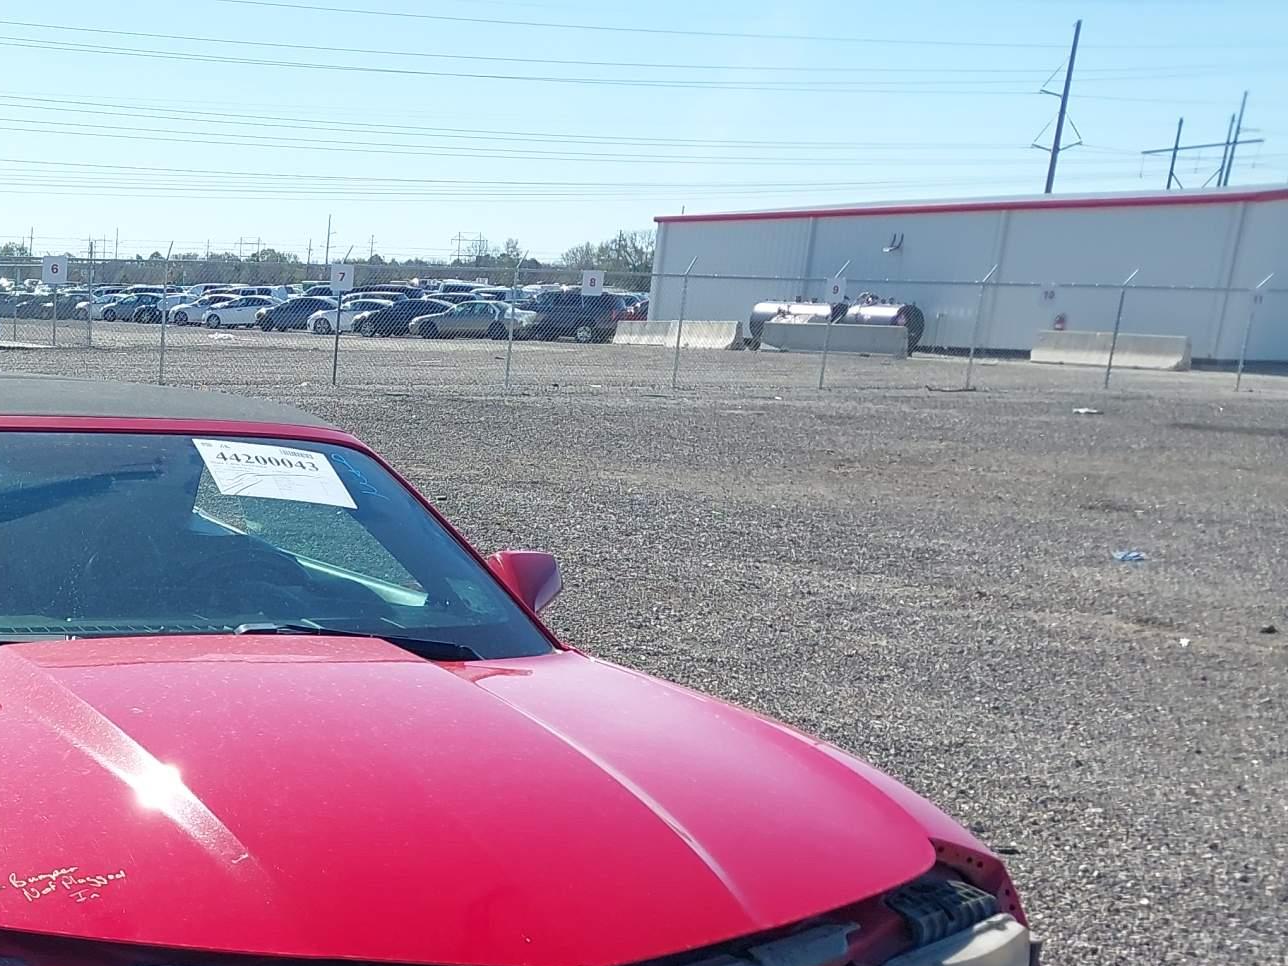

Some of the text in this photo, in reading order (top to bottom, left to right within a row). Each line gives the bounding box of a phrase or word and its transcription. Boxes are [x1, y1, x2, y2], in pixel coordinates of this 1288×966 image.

[51, 263, 59, 274] 6
[336, 271, 346, 282] 7
[589, 277, 596, 287] 8
[832, 285, 839, 295] 9
[1043, 290, 1056, 300] 10
[215, 451, 320, 472] 44200043
[9, 866, 80, 888] Bumper
